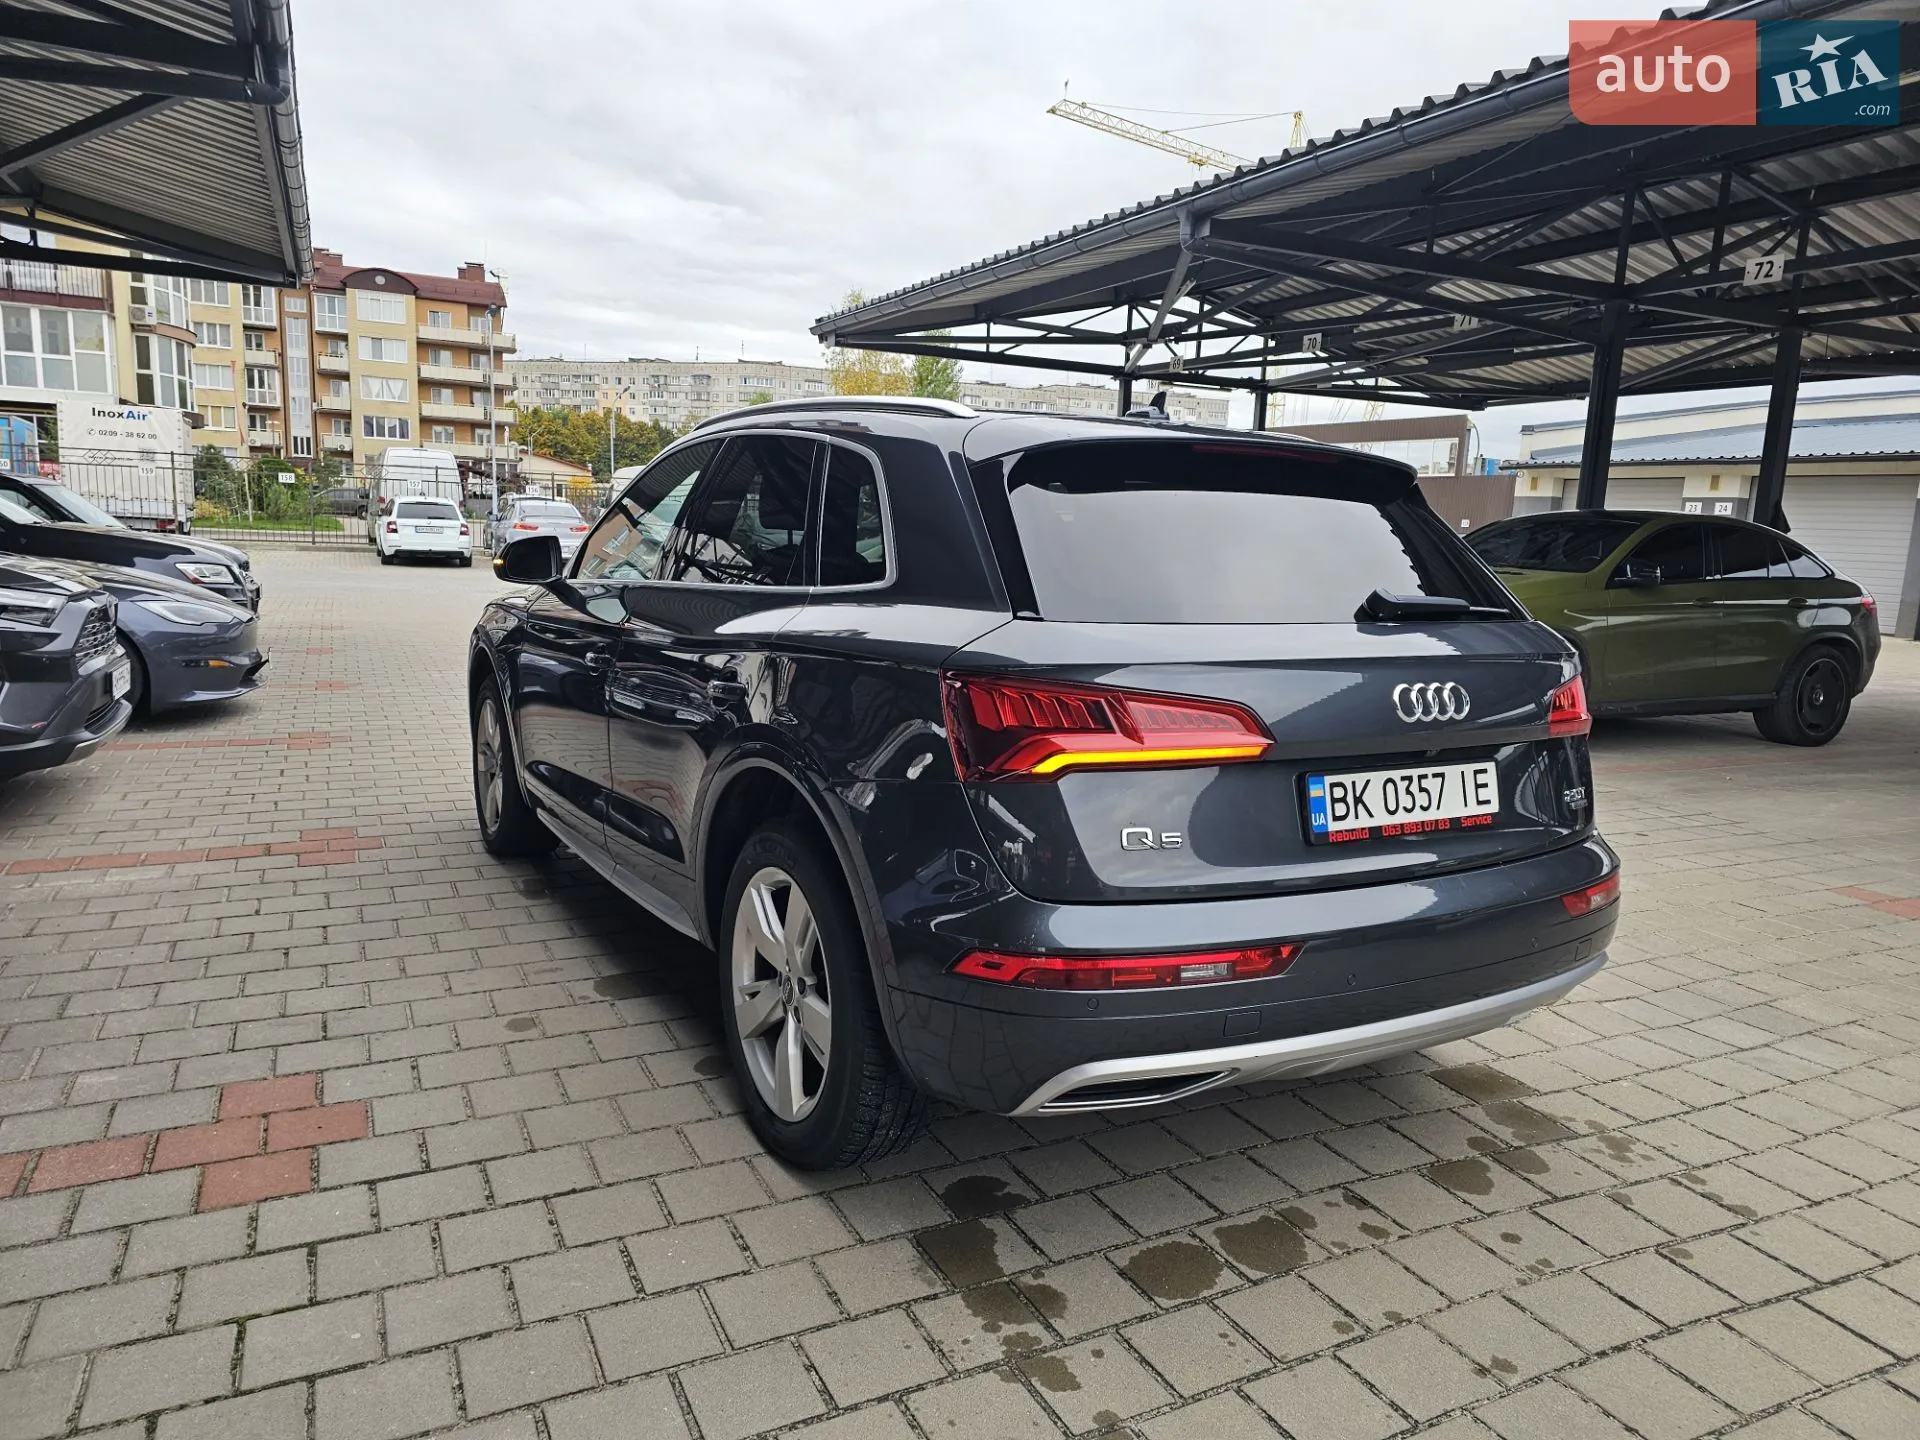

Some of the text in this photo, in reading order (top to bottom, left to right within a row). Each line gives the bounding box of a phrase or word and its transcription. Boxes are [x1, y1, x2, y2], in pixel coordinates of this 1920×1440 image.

[1754, 260, 1774, 280] 72
[1307, 337, 1317, 349] 70
[1172, 358, 1181, 369] 69
[92, 407, 149, 421] InoxAir
[280, 474, 293, 482] 158
[1688, 504, 1698, 513] 23
[1718, 504, 1728, 513] 24
[1329, 767, 1492, 822] BK 0357 IE
[1311, 812, 1327, 826] UA
[1328, 813, 1493, 843] Rebuild 063 893 07 83 Service
[1120, 826, 1183, 851] Q5
